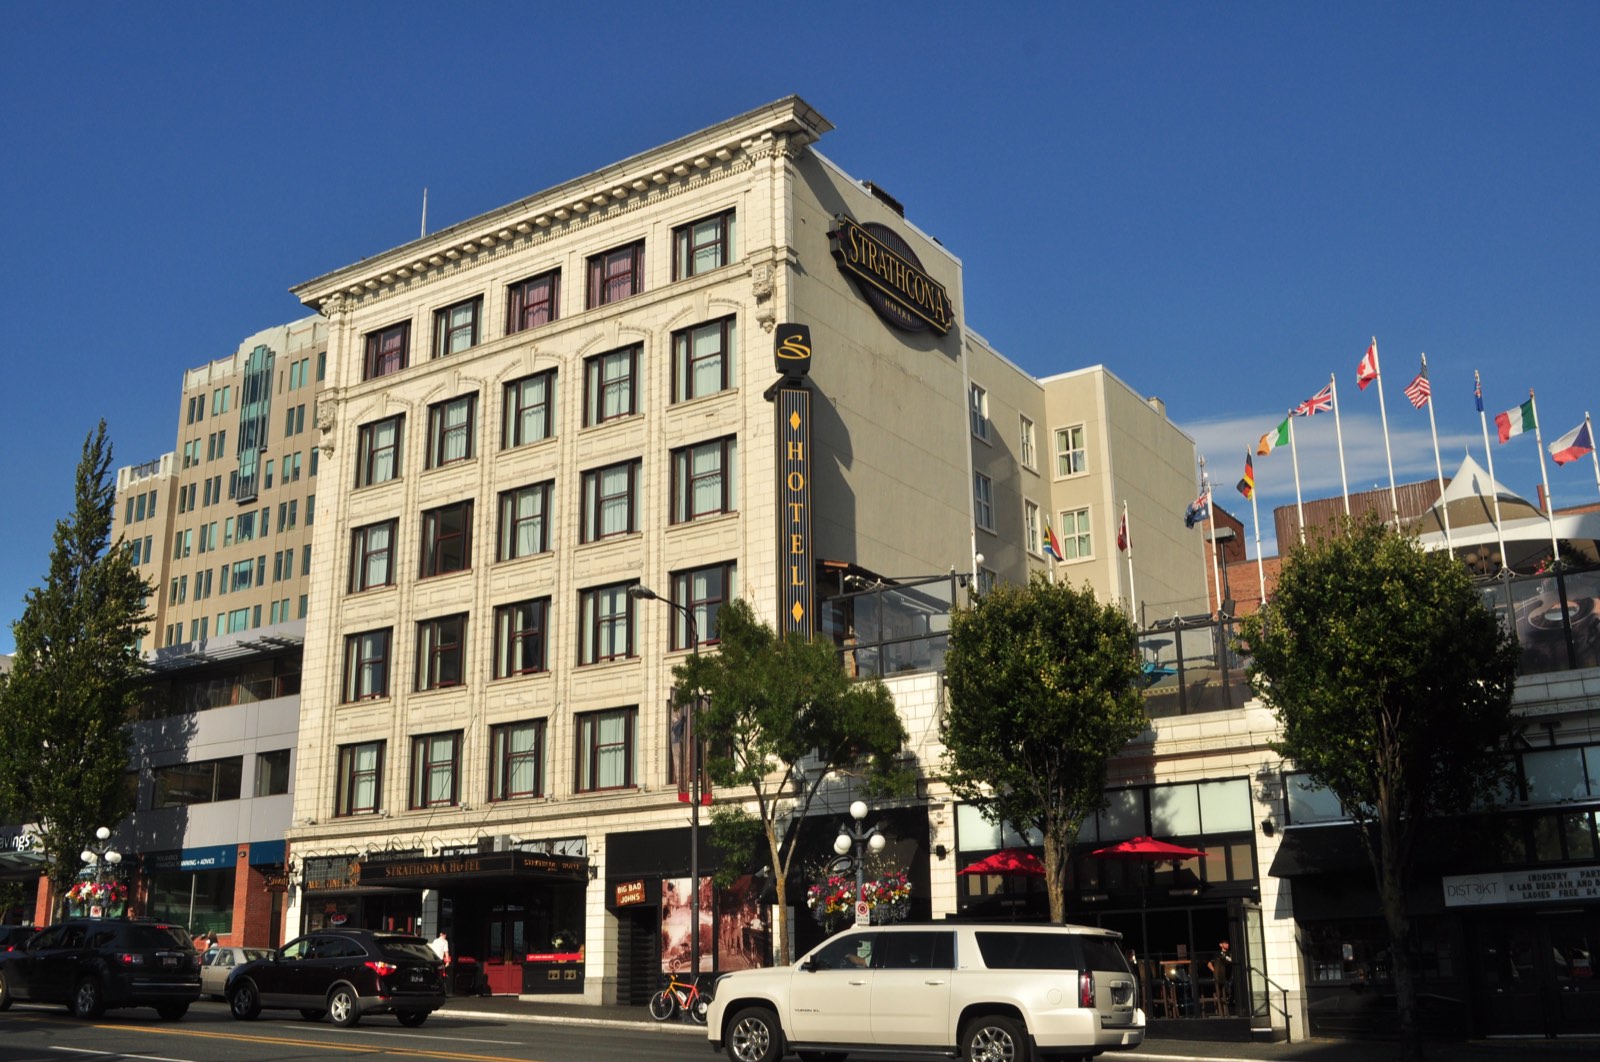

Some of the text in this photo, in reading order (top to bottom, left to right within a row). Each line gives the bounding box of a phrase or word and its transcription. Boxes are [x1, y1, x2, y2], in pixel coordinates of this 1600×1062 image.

[849, 225, 945, 324] STRATHCONA
[884, 298, 912, 322] HOTEL
[787, 441, 805, 586] HOTEL
[385, 860, 480, 877] STRATHCONA HOTEL
[1528, 872, 1568, 882] INDUSTRY
[1536, 881, 1556, 890] DEAD
[1559, 880, 1573, 889] AIR
[1577, 879, 1592, 888] AND
[617, 882, 642, 894] BIG BAD
[1447, 882, 1498, 897] DISTRIKT
[1523, 890, 1551, 900] LADIES
[1559, 888, 1579, 897] FREE
